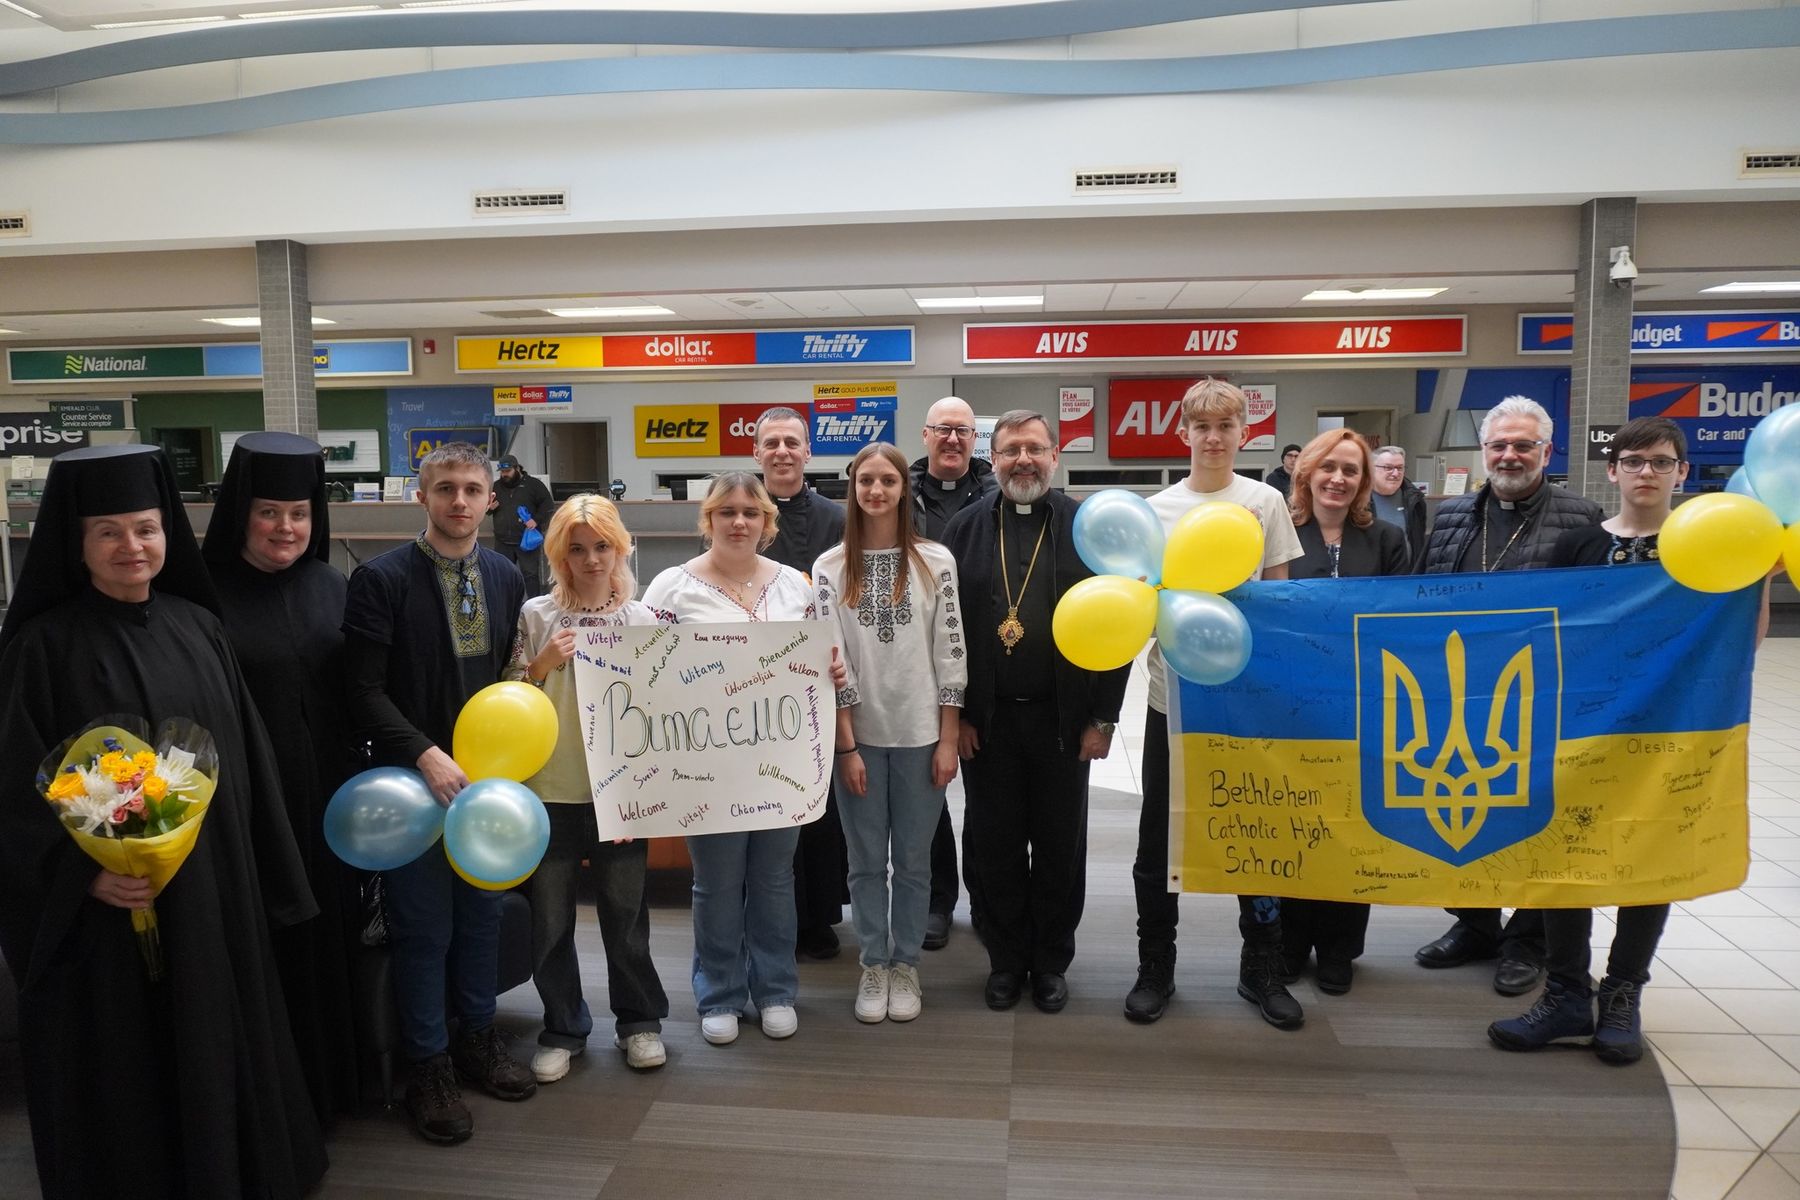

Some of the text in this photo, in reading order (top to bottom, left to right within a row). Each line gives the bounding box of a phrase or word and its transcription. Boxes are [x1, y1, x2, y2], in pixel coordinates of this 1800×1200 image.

[802, 334, 868, 358] Thrifty
[1035, 331, 1089, 353] AVIS
[1184, 329, 1239, 352] AVIS
[1336, 326, 1392, 349] AVIS
[1631, 323, 1682, 347] udget
[497, 341, 560, 360] Hertz
[83, 356, 147, 372] National
[817, 386, 840, 394] Hertz
[401, 401, 425, 412] Travel
[646, 418, 709, 439] Hertz
[816, 415, 888, 442] Thrifty
[1115, 401, 1184, 436] AV
[1591, 430, 1617, 443] Ube
[1697, 428, 1746, 441] Car and
[758, 630, 809, 669] Bienvenido
[679, 660, 726, 685] Witamy
[758, 762, 806, 793] Willkommen
[1208, 769, 1323, 808] Bethlehem
[617, 801, 669, 822] Welcome
[1208, 813, 1333, 849] Catholic High
[1225, 845, 1304, 880] School
